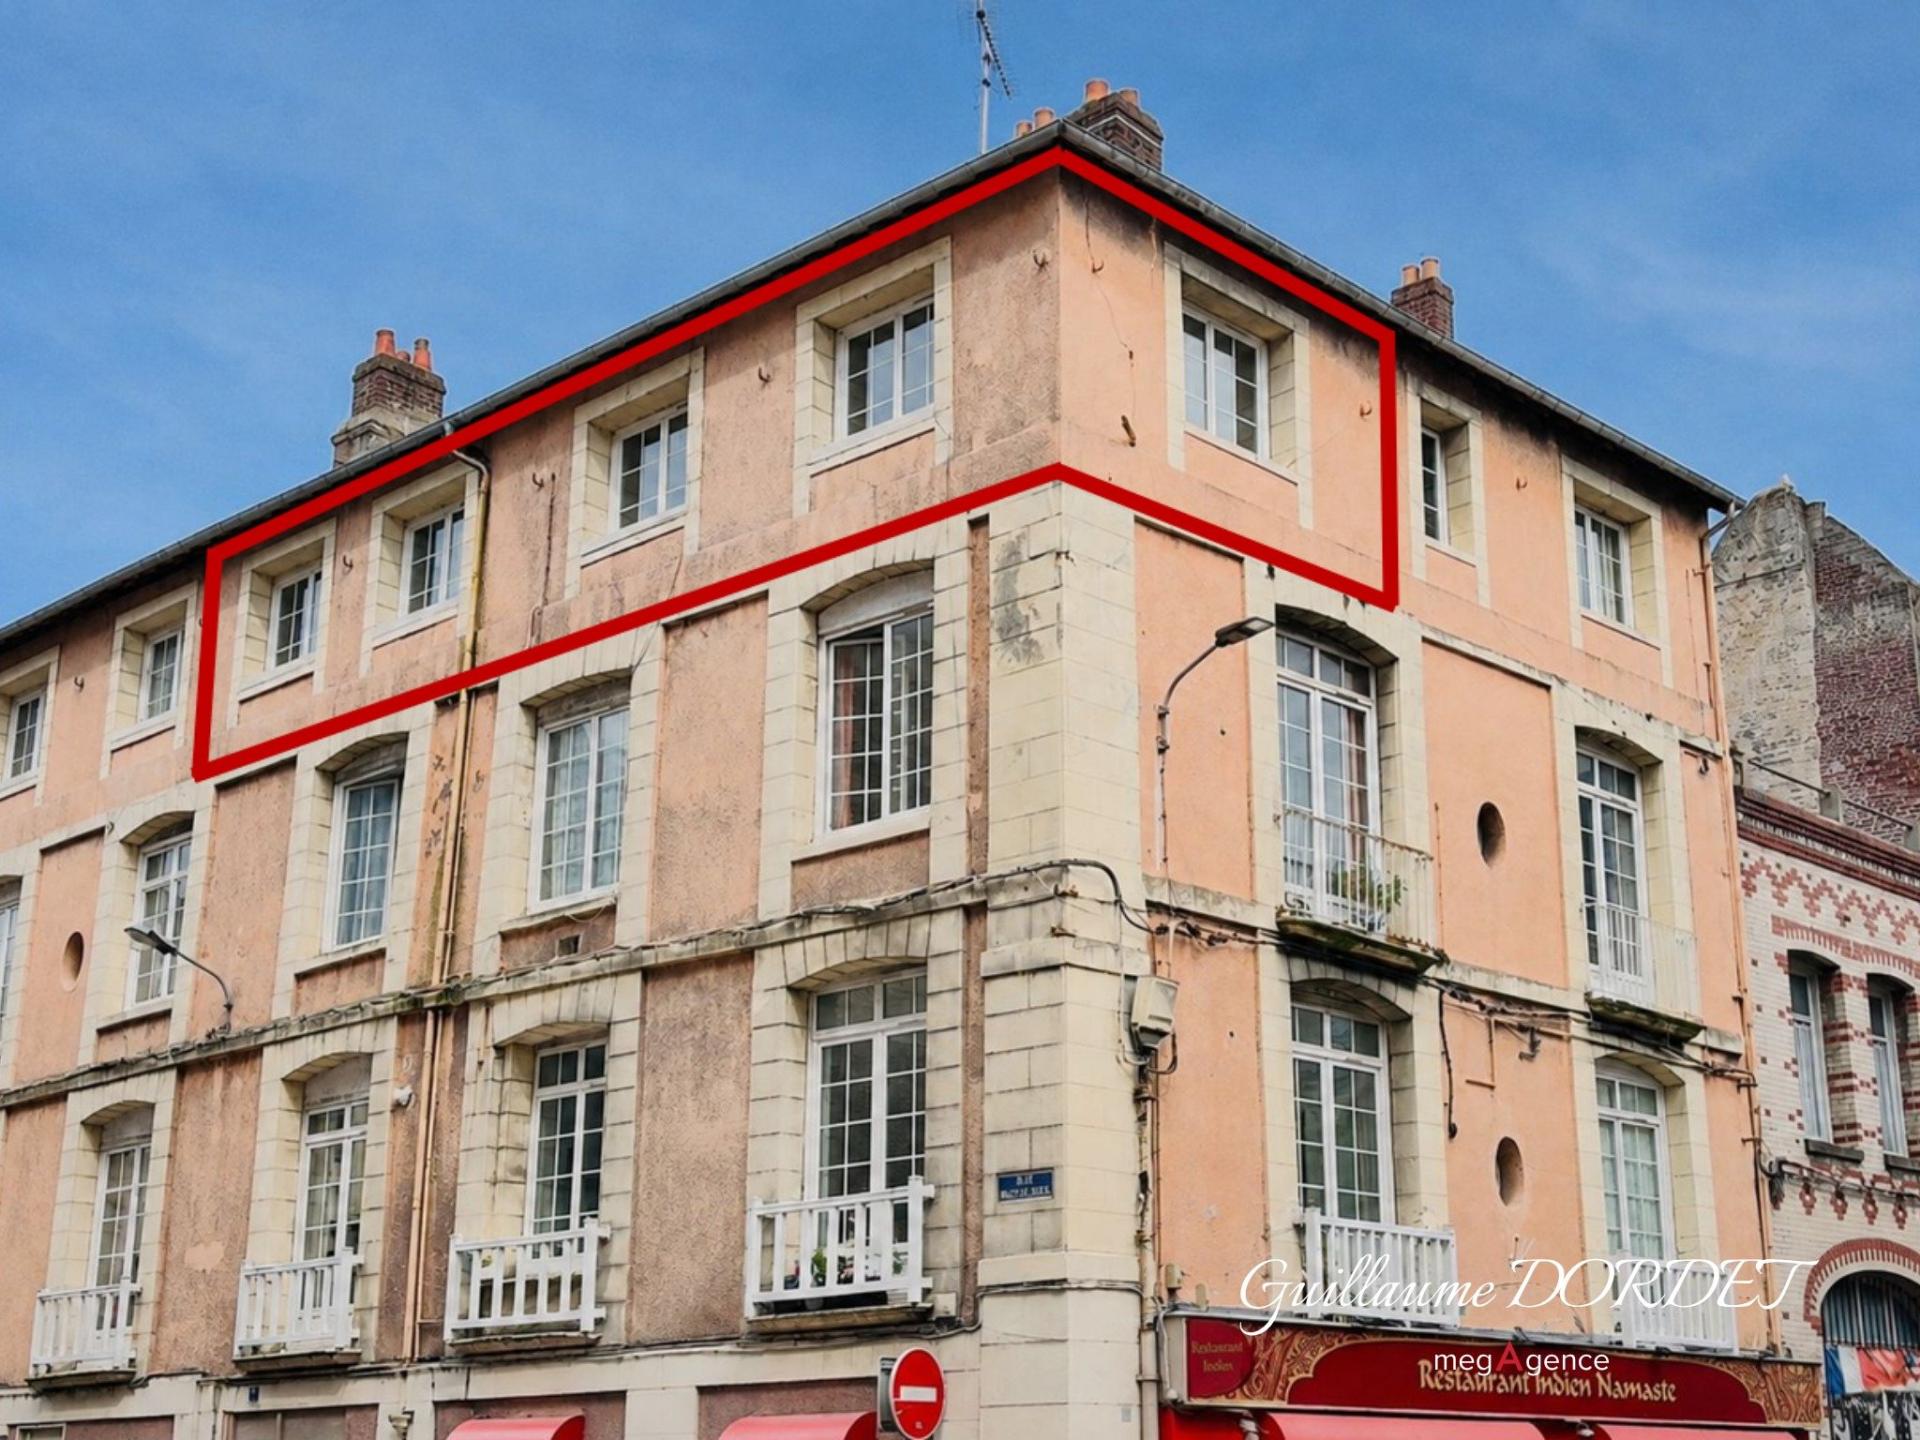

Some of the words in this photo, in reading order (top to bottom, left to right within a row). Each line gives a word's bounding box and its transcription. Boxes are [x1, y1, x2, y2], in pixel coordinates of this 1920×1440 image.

[1417, 1358, 1530, 1396] Restaurant
[1535, 1371, 1592, 1397] Indien
[1595, 1371, 1677, 1402] Namaste
